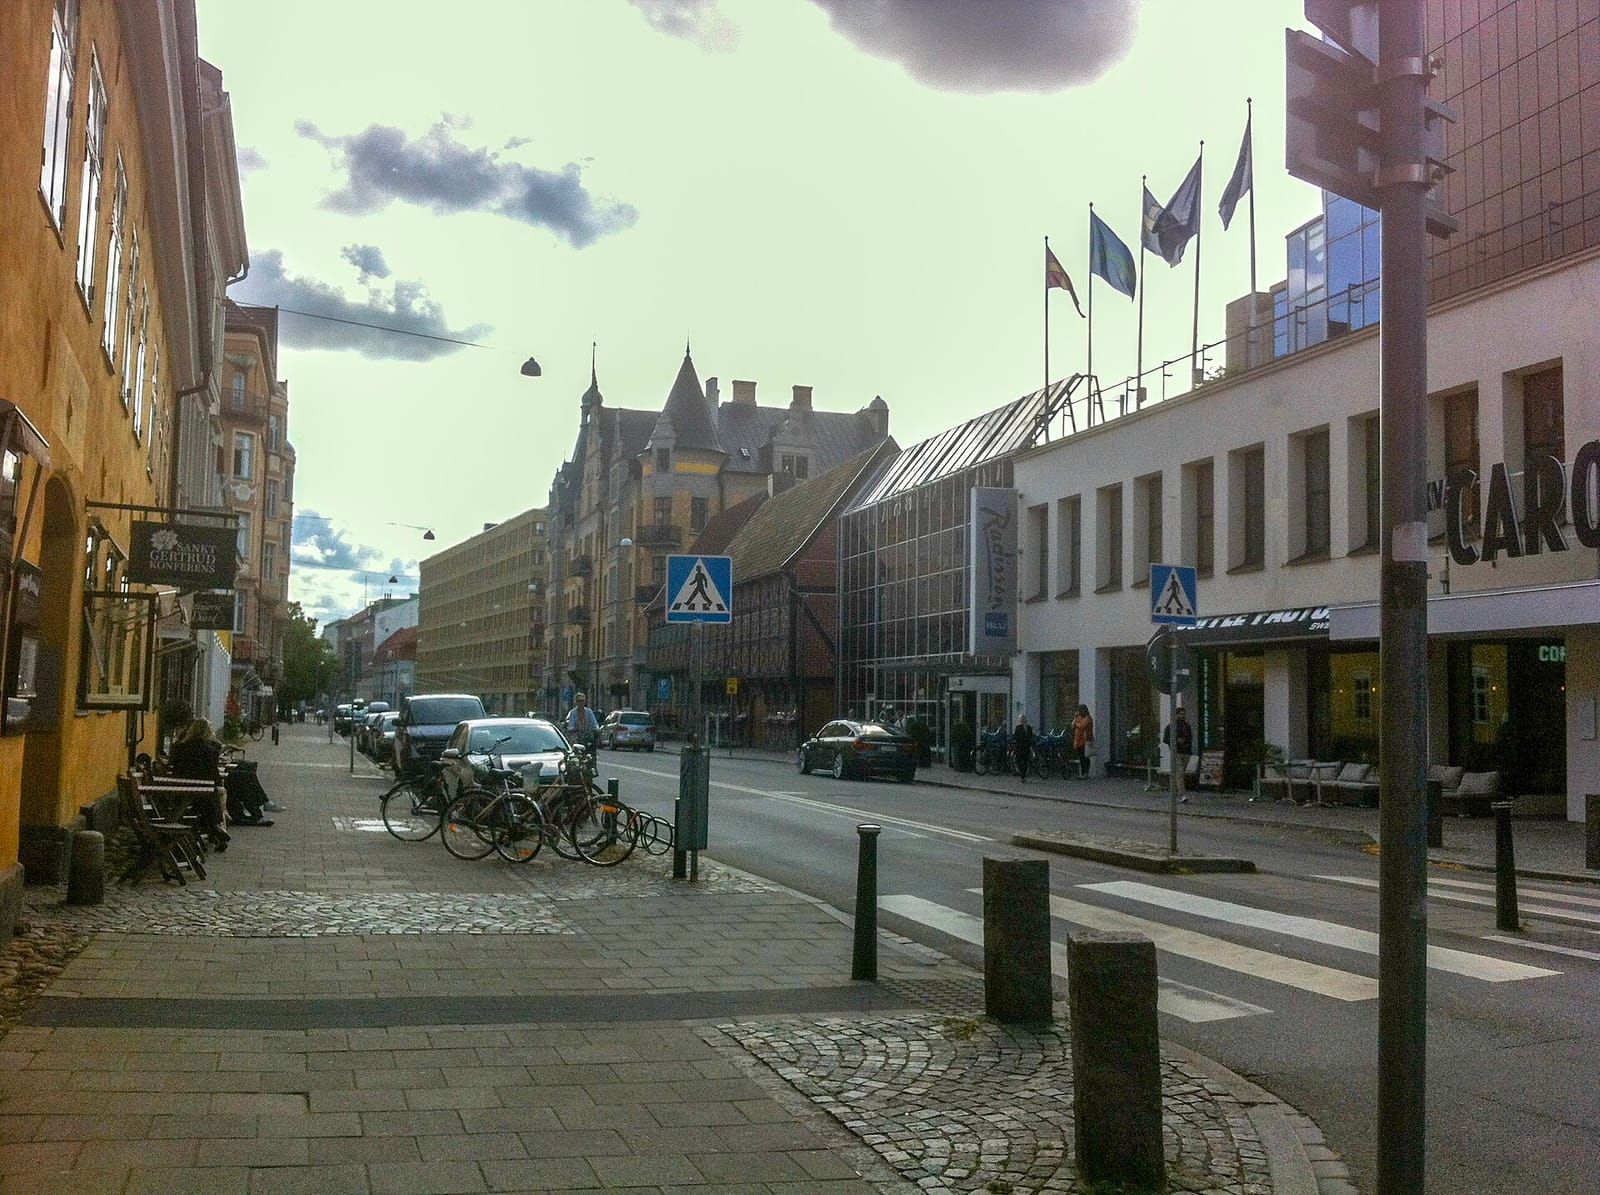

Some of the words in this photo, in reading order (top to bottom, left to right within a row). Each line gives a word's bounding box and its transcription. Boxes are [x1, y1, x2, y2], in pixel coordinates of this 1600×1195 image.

[177, 542, 217, 553] SANKT
[150, 550, 216, 564] GERTRUD
[979, 506, 1016, 611] Radisson
[150, 561, 215, 573] KONFERENS
